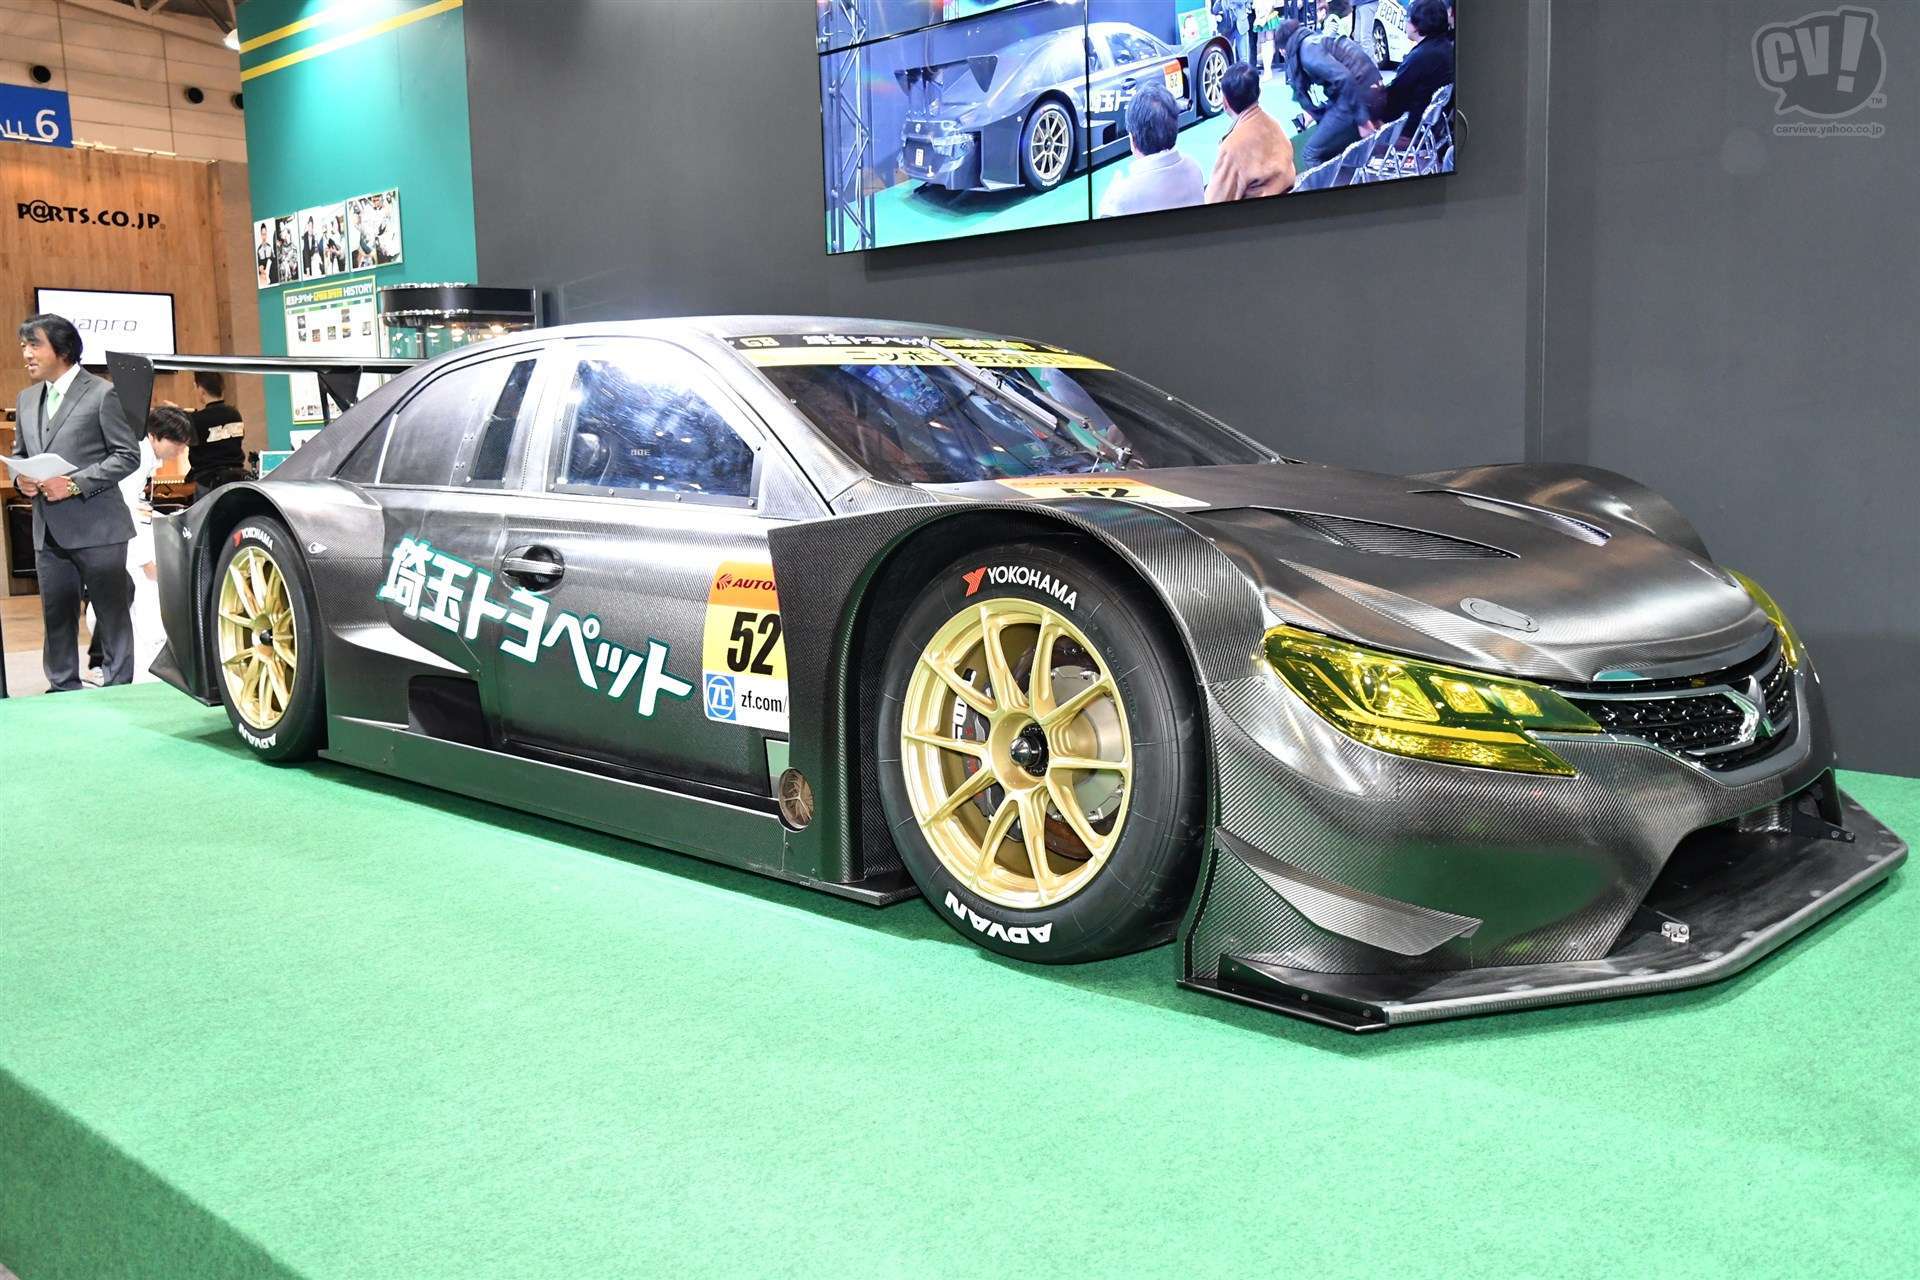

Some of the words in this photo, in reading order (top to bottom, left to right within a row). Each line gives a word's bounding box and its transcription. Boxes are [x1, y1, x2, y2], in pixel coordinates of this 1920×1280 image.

[35, 109, 60, 141] 6
[343, 283, 373, 297] HISTORY
[243, 527, 274, 551] YOKOHAMA
[732, 578, 777, 592] AUTO
[987, 565, 1078, 611] YOKOHAMA
[379, 536, 694, 718] 埼玉トヨペット
[727, 611, 783, 676] 52
[710, 684, 732, 707] ZF
[238, 722, 277, 749] ADVAN
[945, 890, 1053, 944] ADVAN
